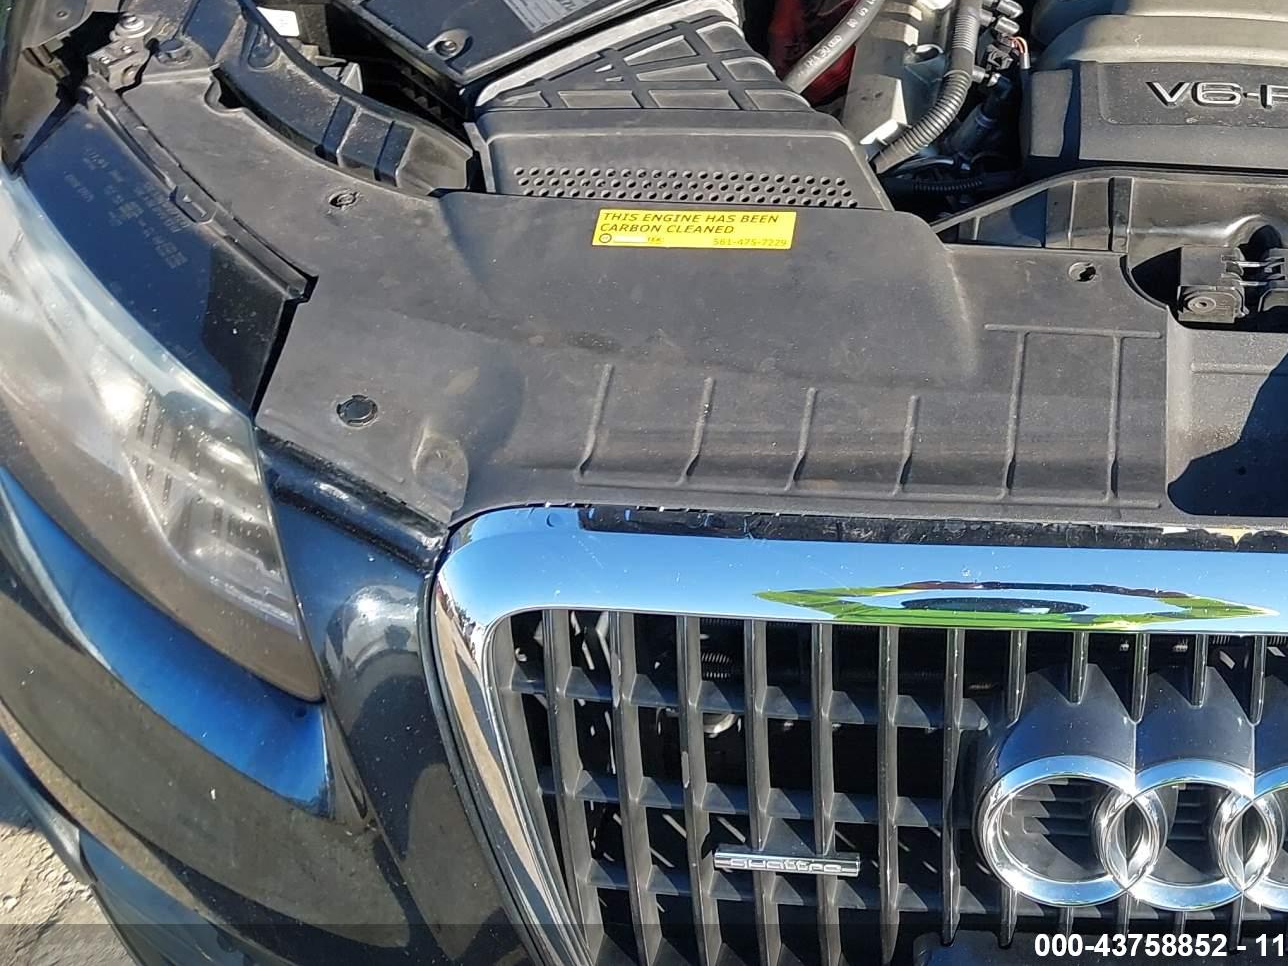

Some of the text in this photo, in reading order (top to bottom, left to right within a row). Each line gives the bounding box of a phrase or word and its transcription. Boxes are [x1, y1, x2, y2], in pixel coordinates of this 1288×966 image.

[603, 212, 780, 224] THIS ENGINE HAS BEEN
[600, 223, 735, 234] CARBON CLEANED
[730, 858, 842, 873] quattro
